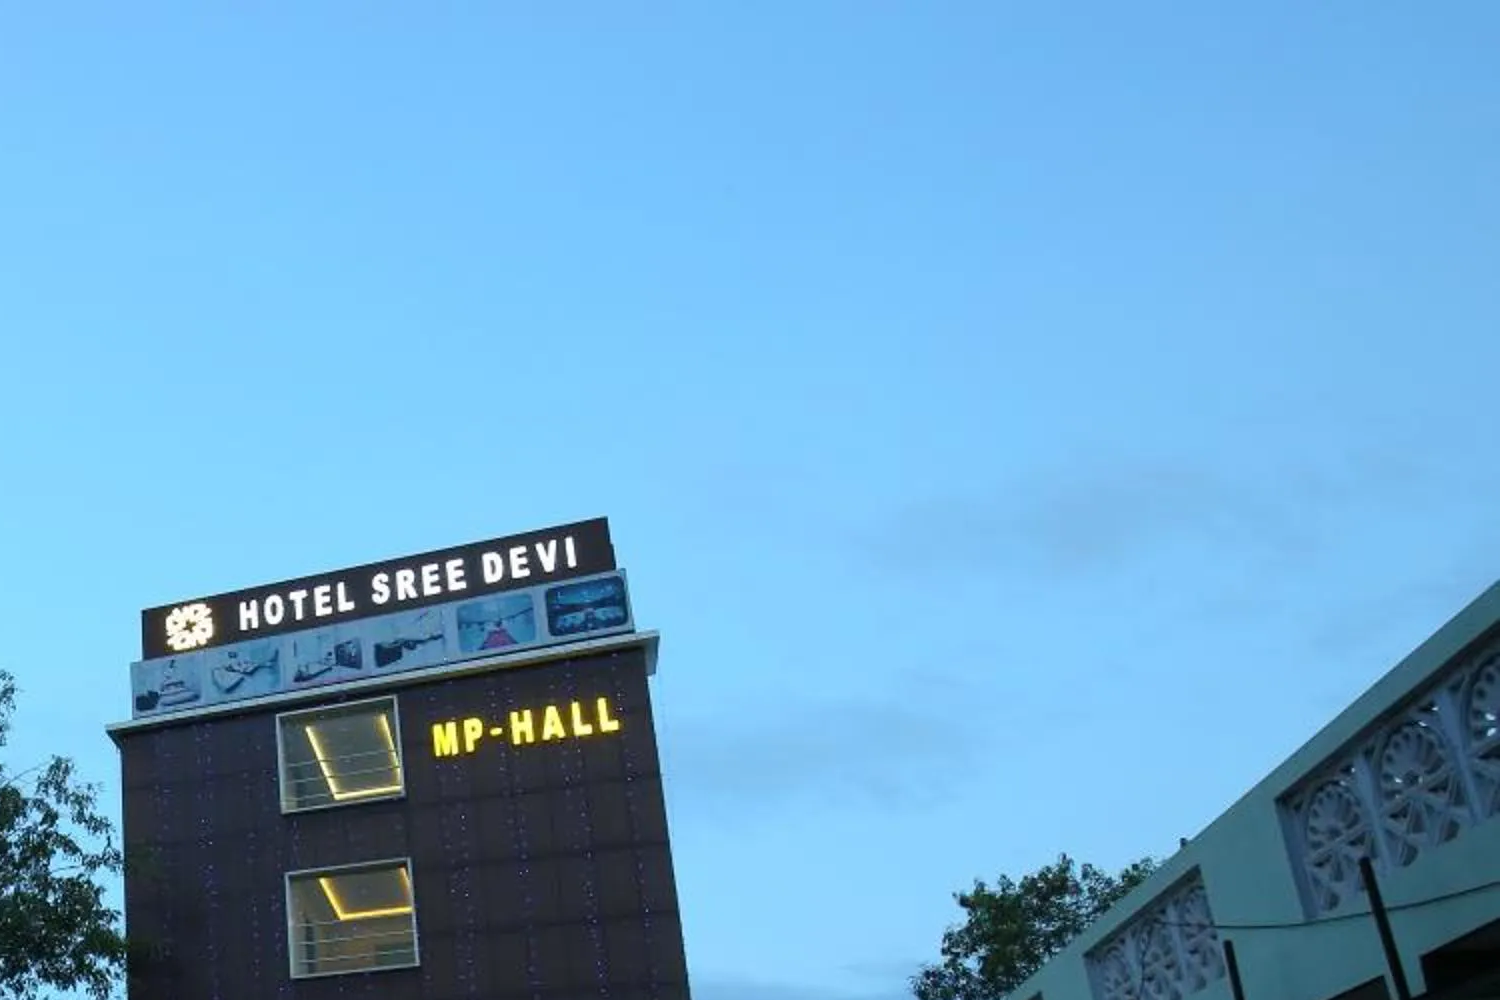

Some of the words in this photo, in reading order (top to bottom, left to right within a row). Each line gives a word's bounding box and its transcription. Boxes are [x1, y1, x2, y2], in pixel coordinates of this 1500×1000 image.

[238, 581, 355, 631] HOTEL
[372, 558, 467, 605] SREE
[483, 537, 578, 584] DEVI
[431, 697, 621, 758] MP-HALL
